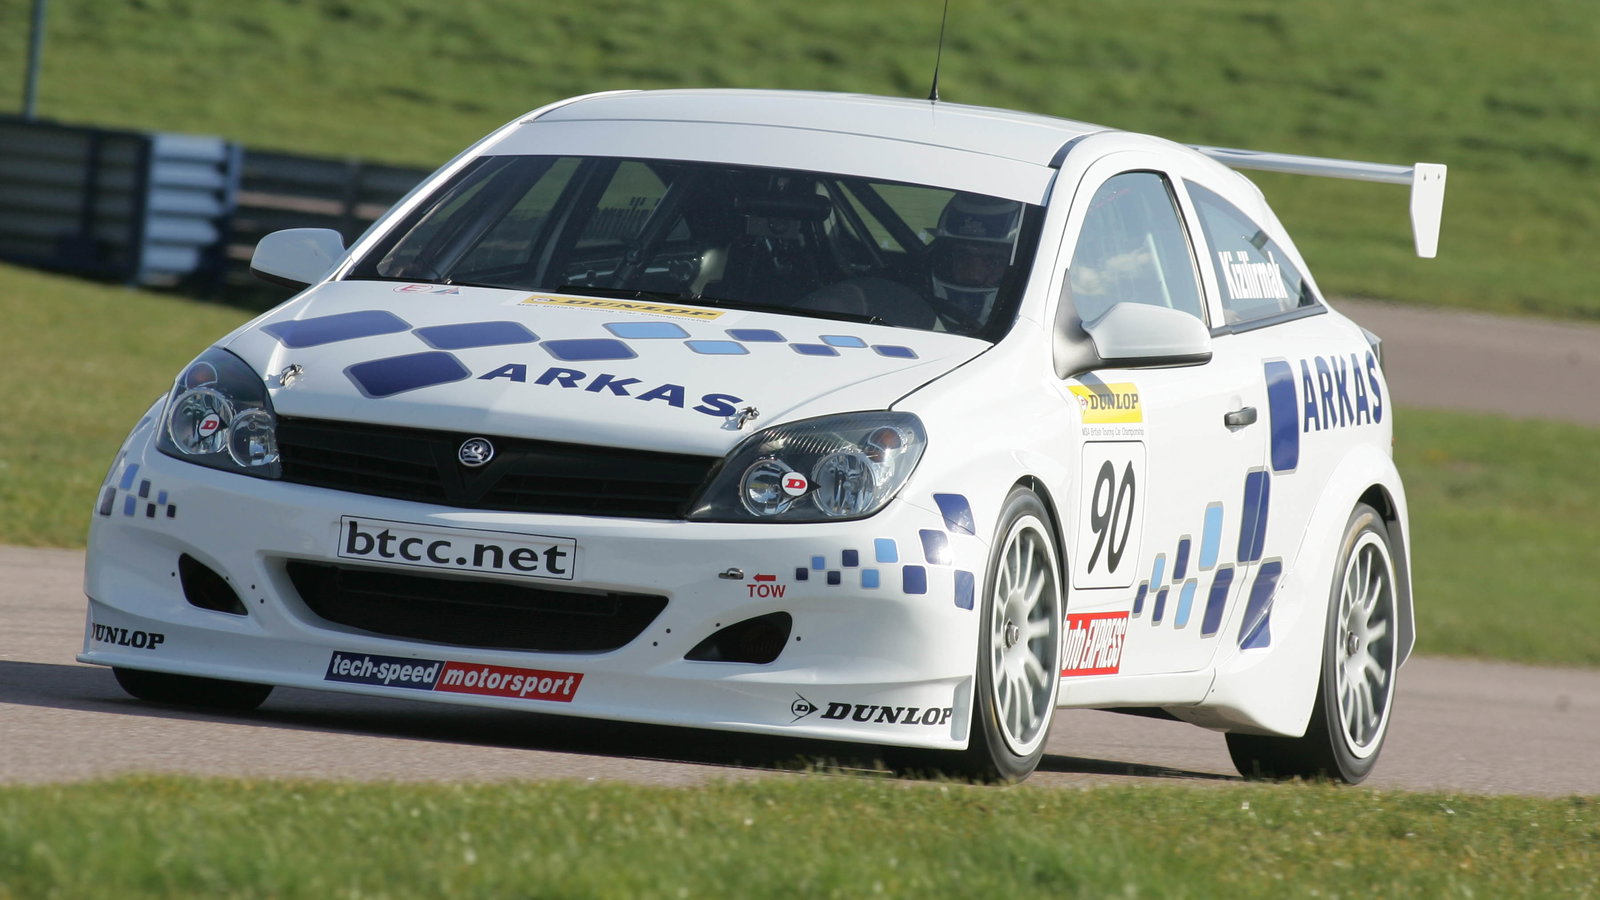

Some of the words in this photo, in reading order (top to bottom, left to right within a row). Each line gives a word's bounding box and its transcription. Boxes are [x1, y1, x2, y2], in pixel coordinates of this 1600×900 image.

[559, 299, 718, 317] DUNLOP
[476, 363, 744, 417] ARKAS
[1088, 393, 1139, 410] DUNLOP
[1299, 350, 1383, 433] ARKAS
[785, 478, 807, 489] D
[1087, 459, 1136, 575] 90
[345, 520, 568, 575] btcc.net
[746, 584, 786, 598] TOW
[1079, 617, 1128, 670] EXPRESS
[333, 654, 440, 685] tech-speed
[442, 667, 575, 697] motorsport
[820, 702, 953, 726] DUNLOP
